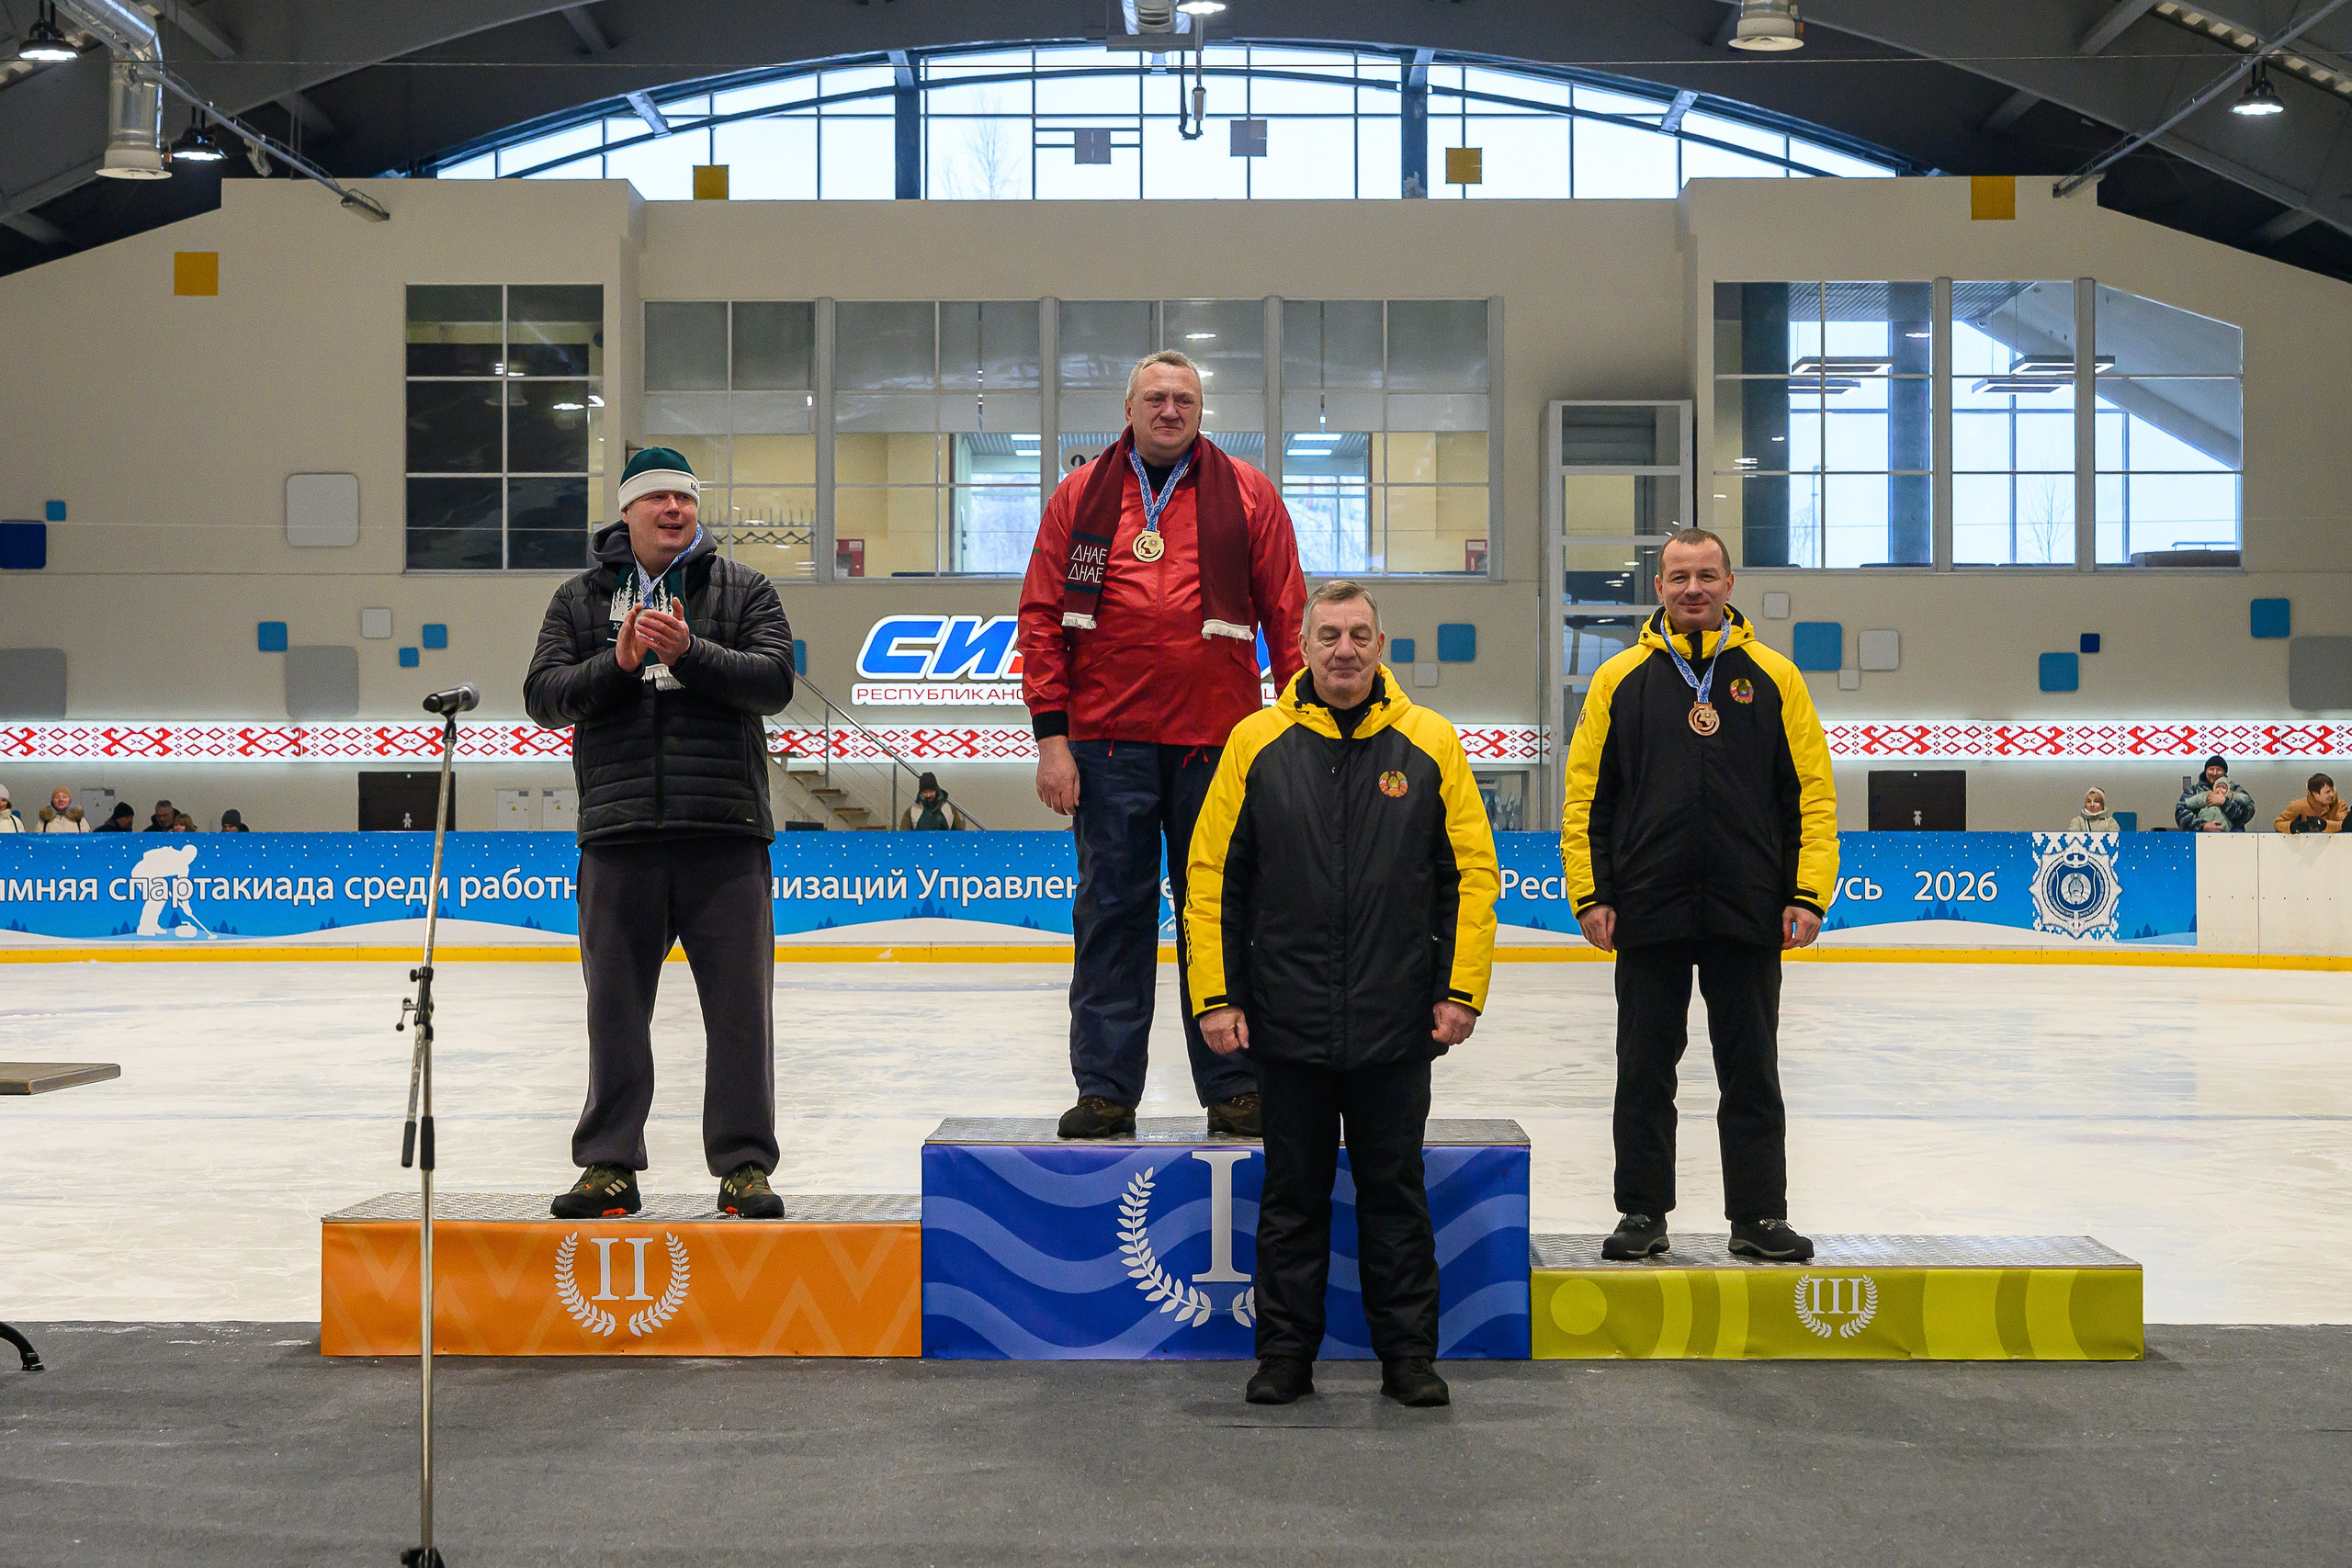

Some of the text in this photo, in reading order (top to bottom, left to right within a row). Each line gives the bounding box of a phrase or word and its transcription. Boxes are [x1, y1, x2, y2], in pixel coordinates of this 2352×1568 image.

[860, 618, 1024, 676] СИ
[0, 877, 98, 901] мняя
[108, 875, 335, 908] спартакиада
[1914, 870, 1998, 901] 2026
[1193, 1151, 1251, 1281] I
[590, 1237, 654, 1301] II
[1808, 1278, 1864, 1314] III
